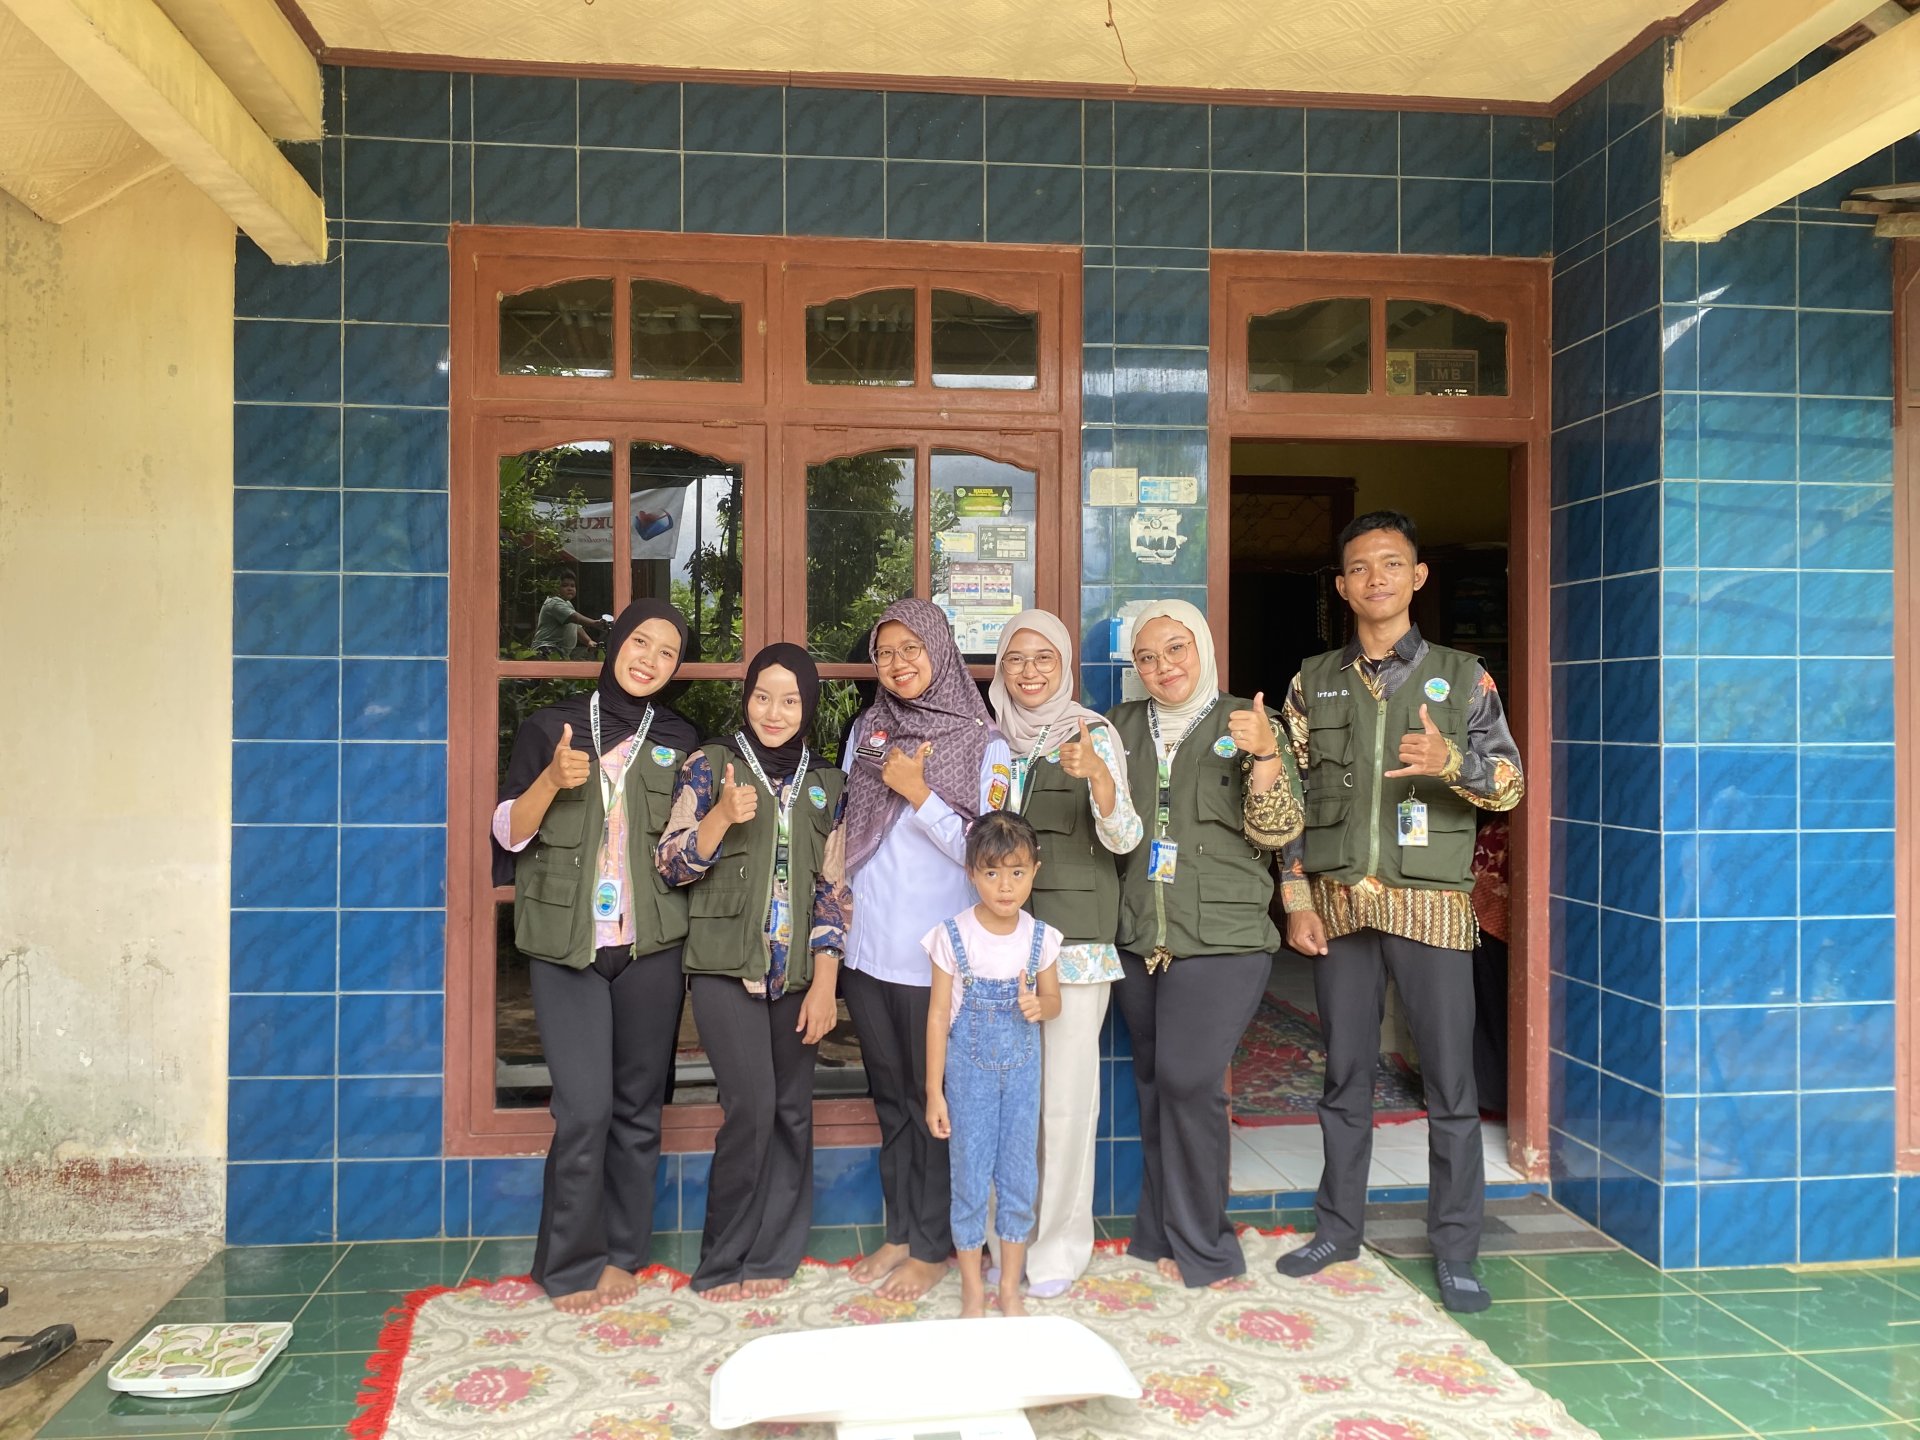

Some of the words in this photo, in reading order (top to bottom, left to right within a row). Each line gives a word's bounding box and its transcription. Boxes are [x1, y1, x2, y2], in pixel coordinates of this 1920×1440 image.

[1431, 368, 1461, 380] IMB
[1037, 731, 1048, 746] DESA
[630, 740, 640, 755] DESA
